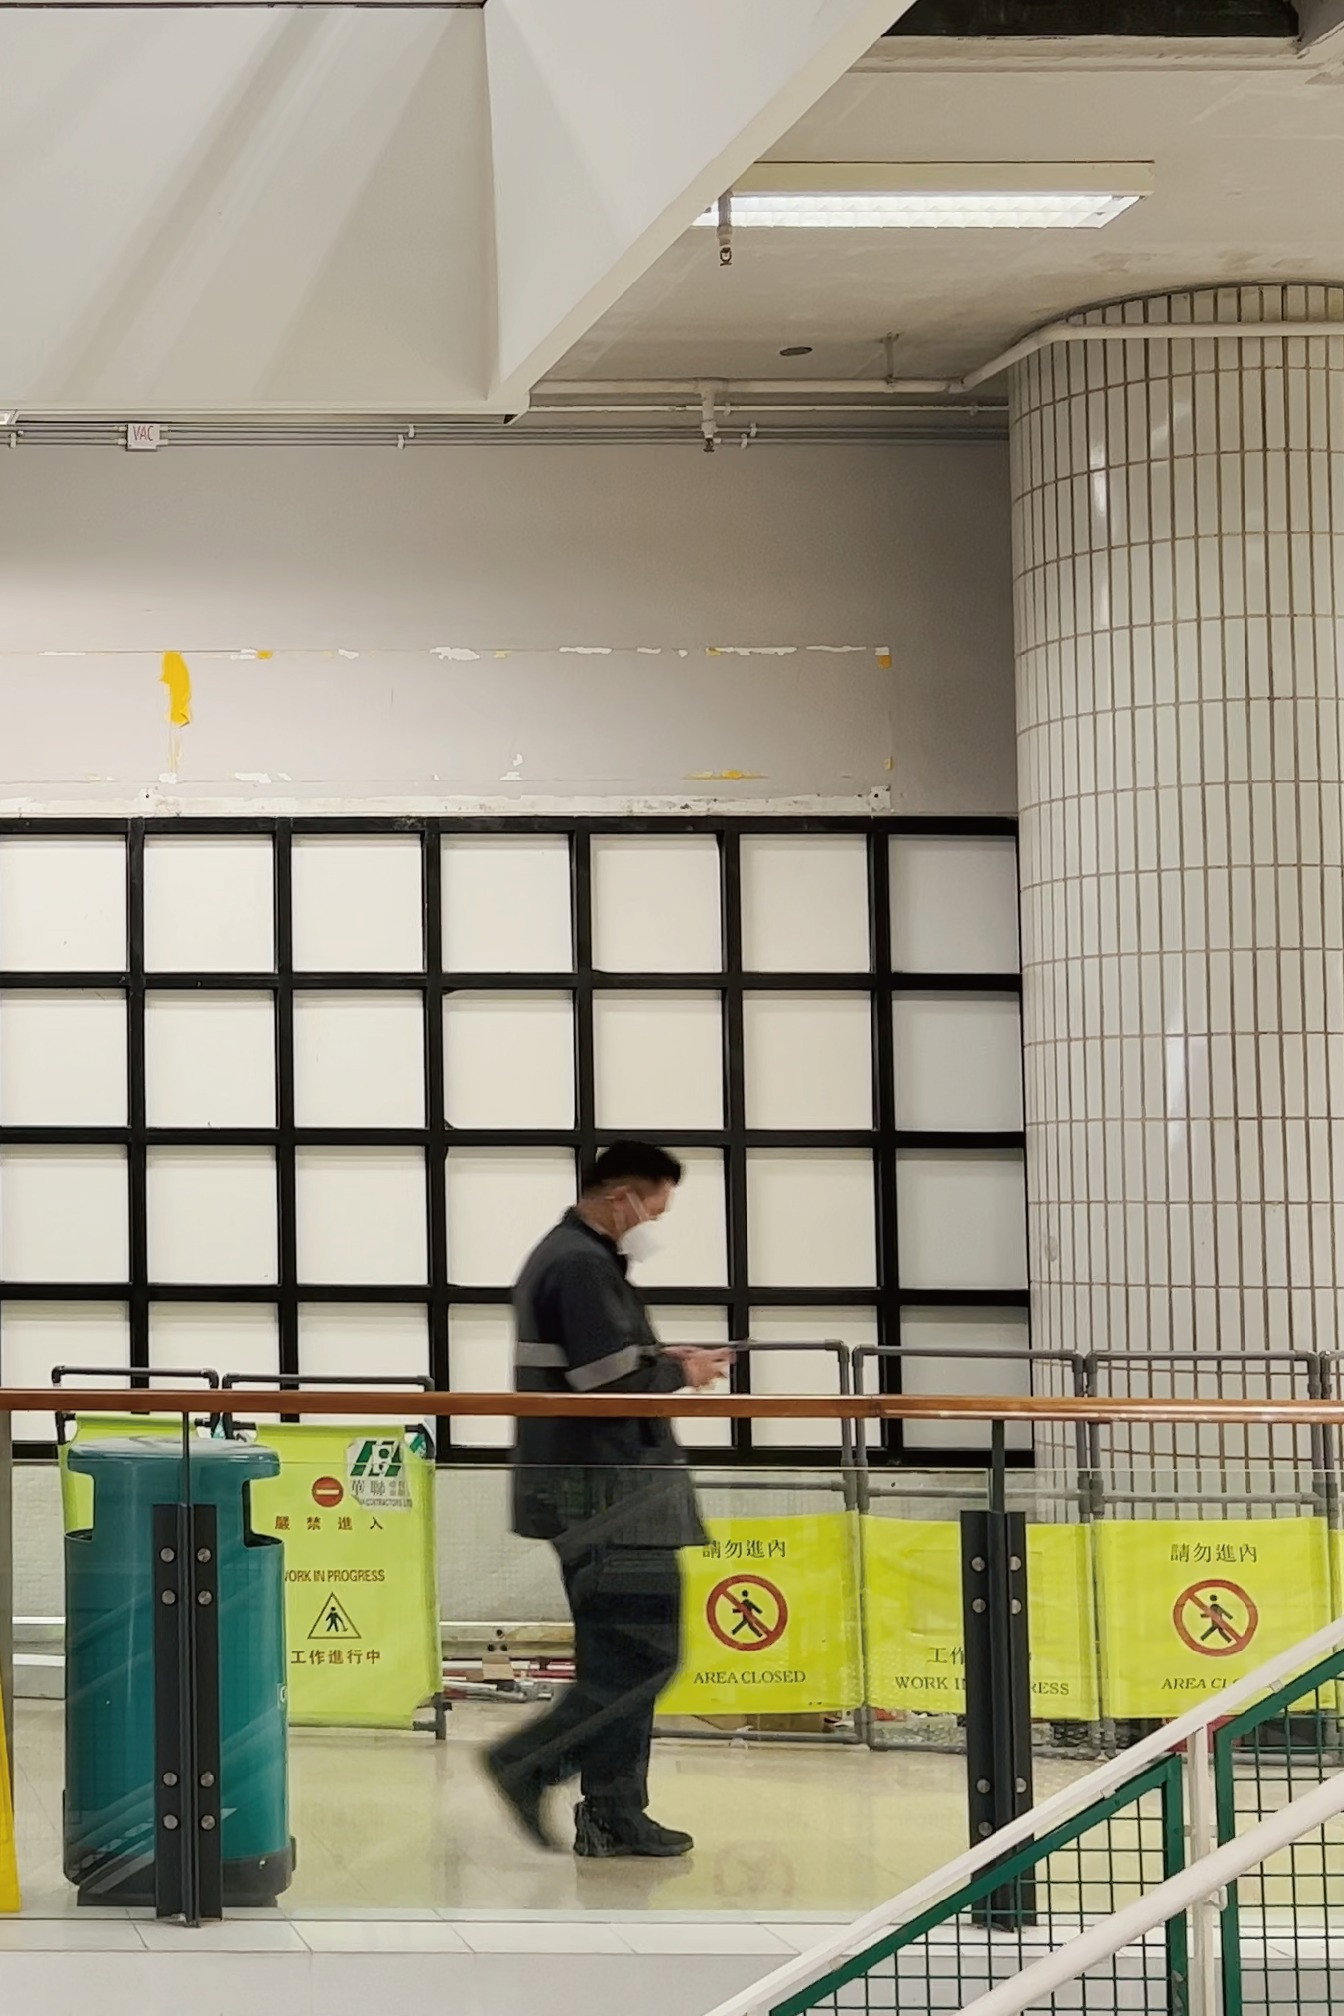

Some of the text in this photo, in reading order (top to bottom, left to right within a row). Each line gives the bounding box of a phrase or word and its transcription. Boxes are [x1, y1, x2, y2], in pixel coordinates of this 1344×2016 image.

[132, 425, 154, 441] VAC
[1170, 1542, 1258, 1563] 請勿進內
[284, 1568, 386, 1582] ORK IN PROGRESS
[290, 1649, 380, 1665] 工作進行中
[693, 1669, 806, 1685] AREA CLOSED
[894, 1675, 949, 1691] WORK
[1161, 1678, 1207, 1690] AREA
